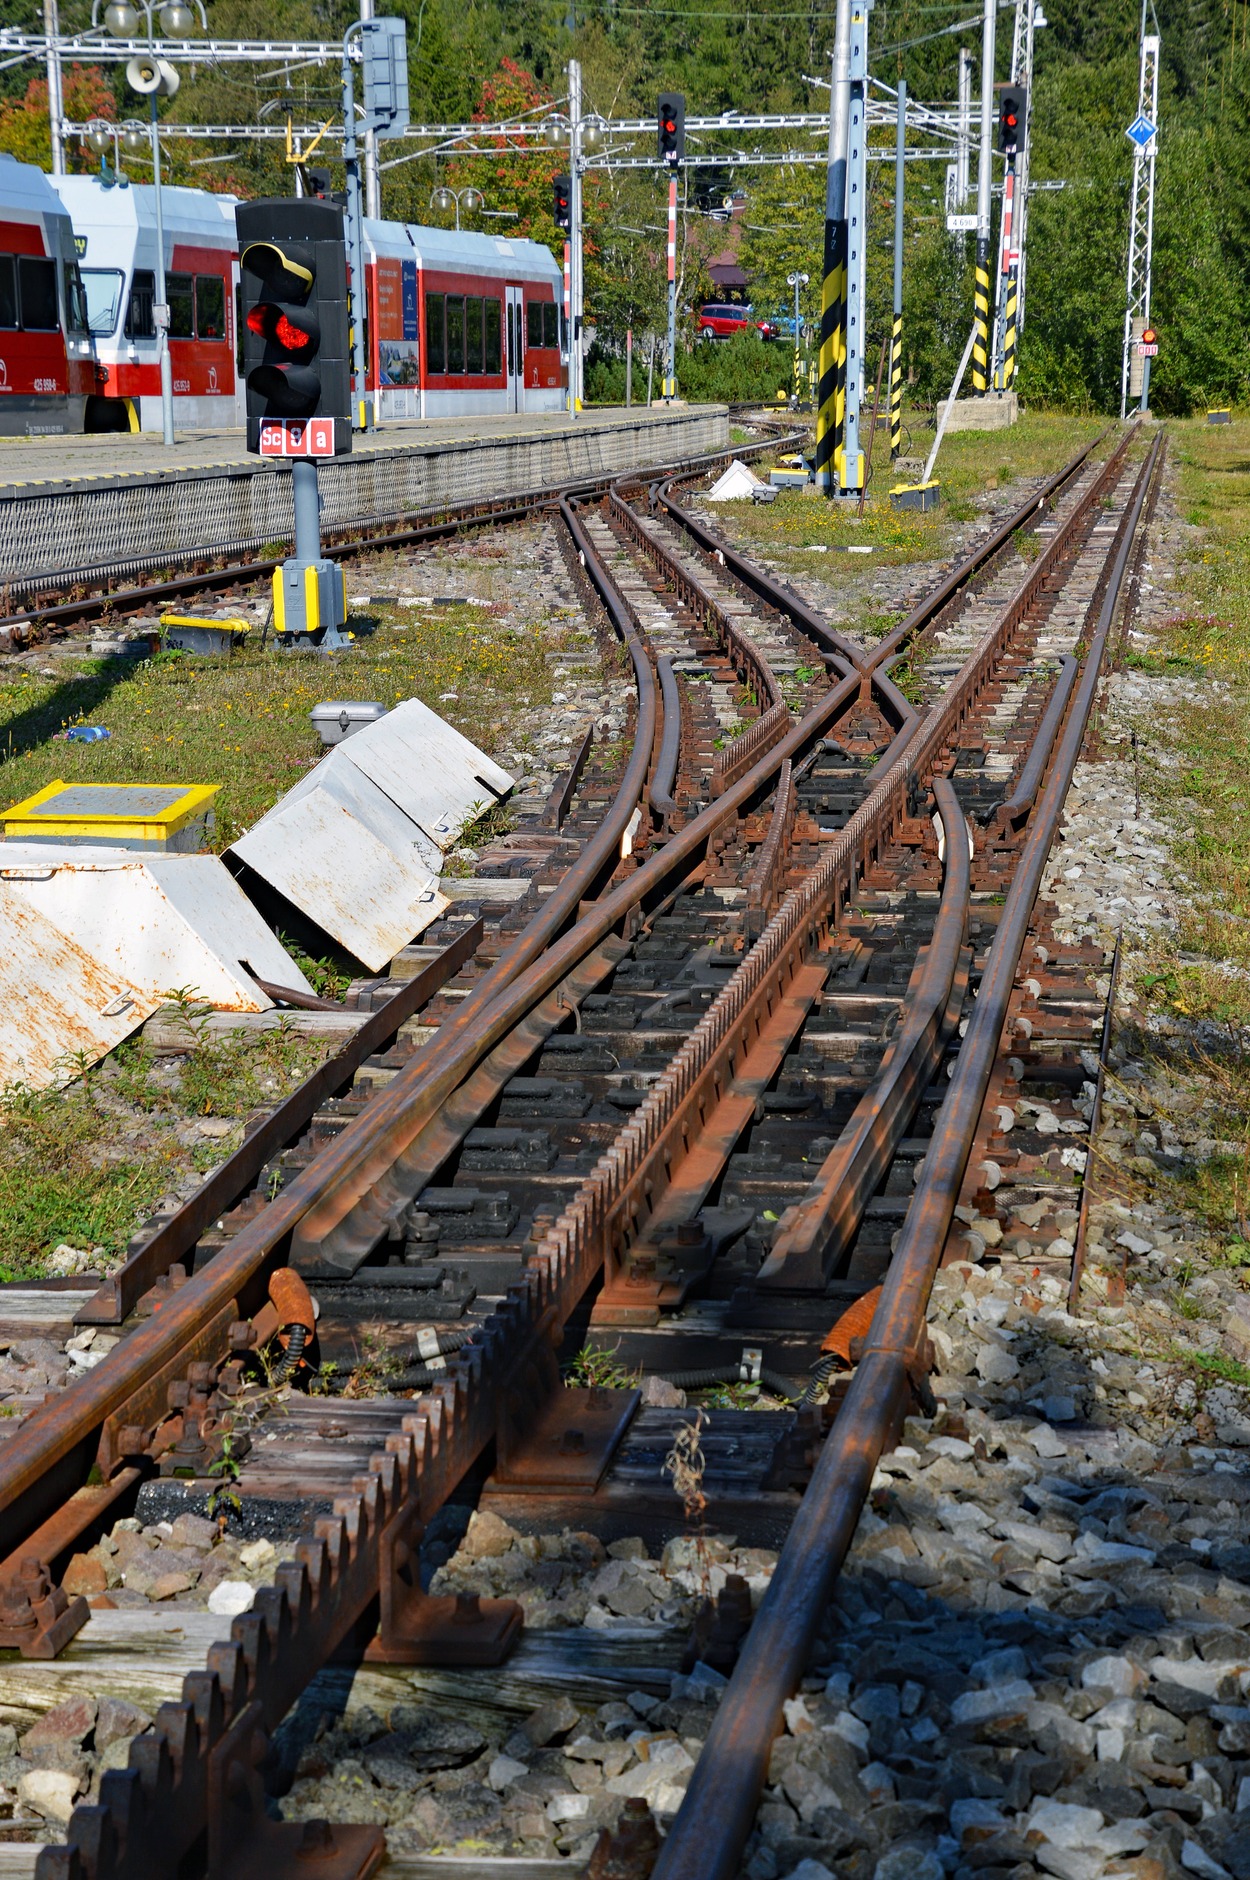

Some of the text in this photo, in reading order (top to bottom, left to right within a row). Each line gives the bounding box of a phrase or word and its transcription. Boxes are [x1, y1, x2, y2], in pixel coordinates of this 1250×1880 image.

[262, 426, 327, 448] Sc 9 a
